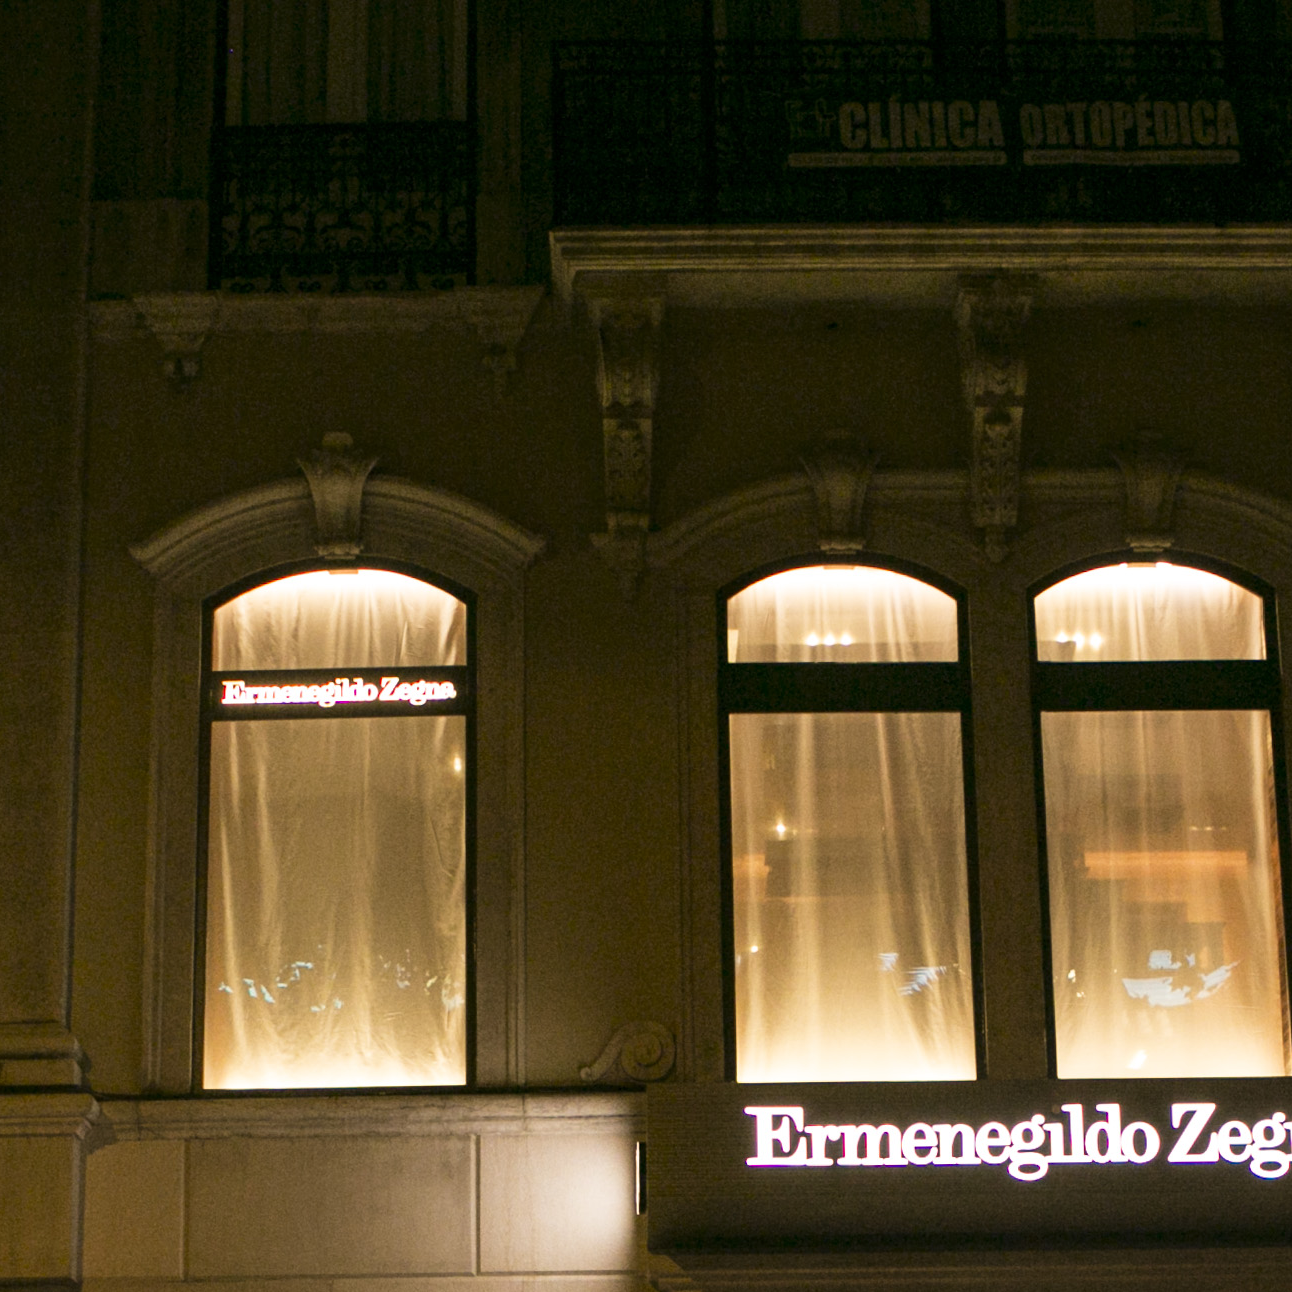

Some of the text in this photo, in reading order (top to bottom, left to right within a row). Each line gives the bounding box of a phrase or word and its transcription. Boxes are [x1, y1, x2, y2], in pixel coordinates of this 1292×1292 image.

[838, 93, 1240, 149] CLÍNICA ORTOPÉDICA
[221, 677, 457, 708] Ermenegildo Zegna
[744, 1104, 1161, 1181] Ermenegildo
